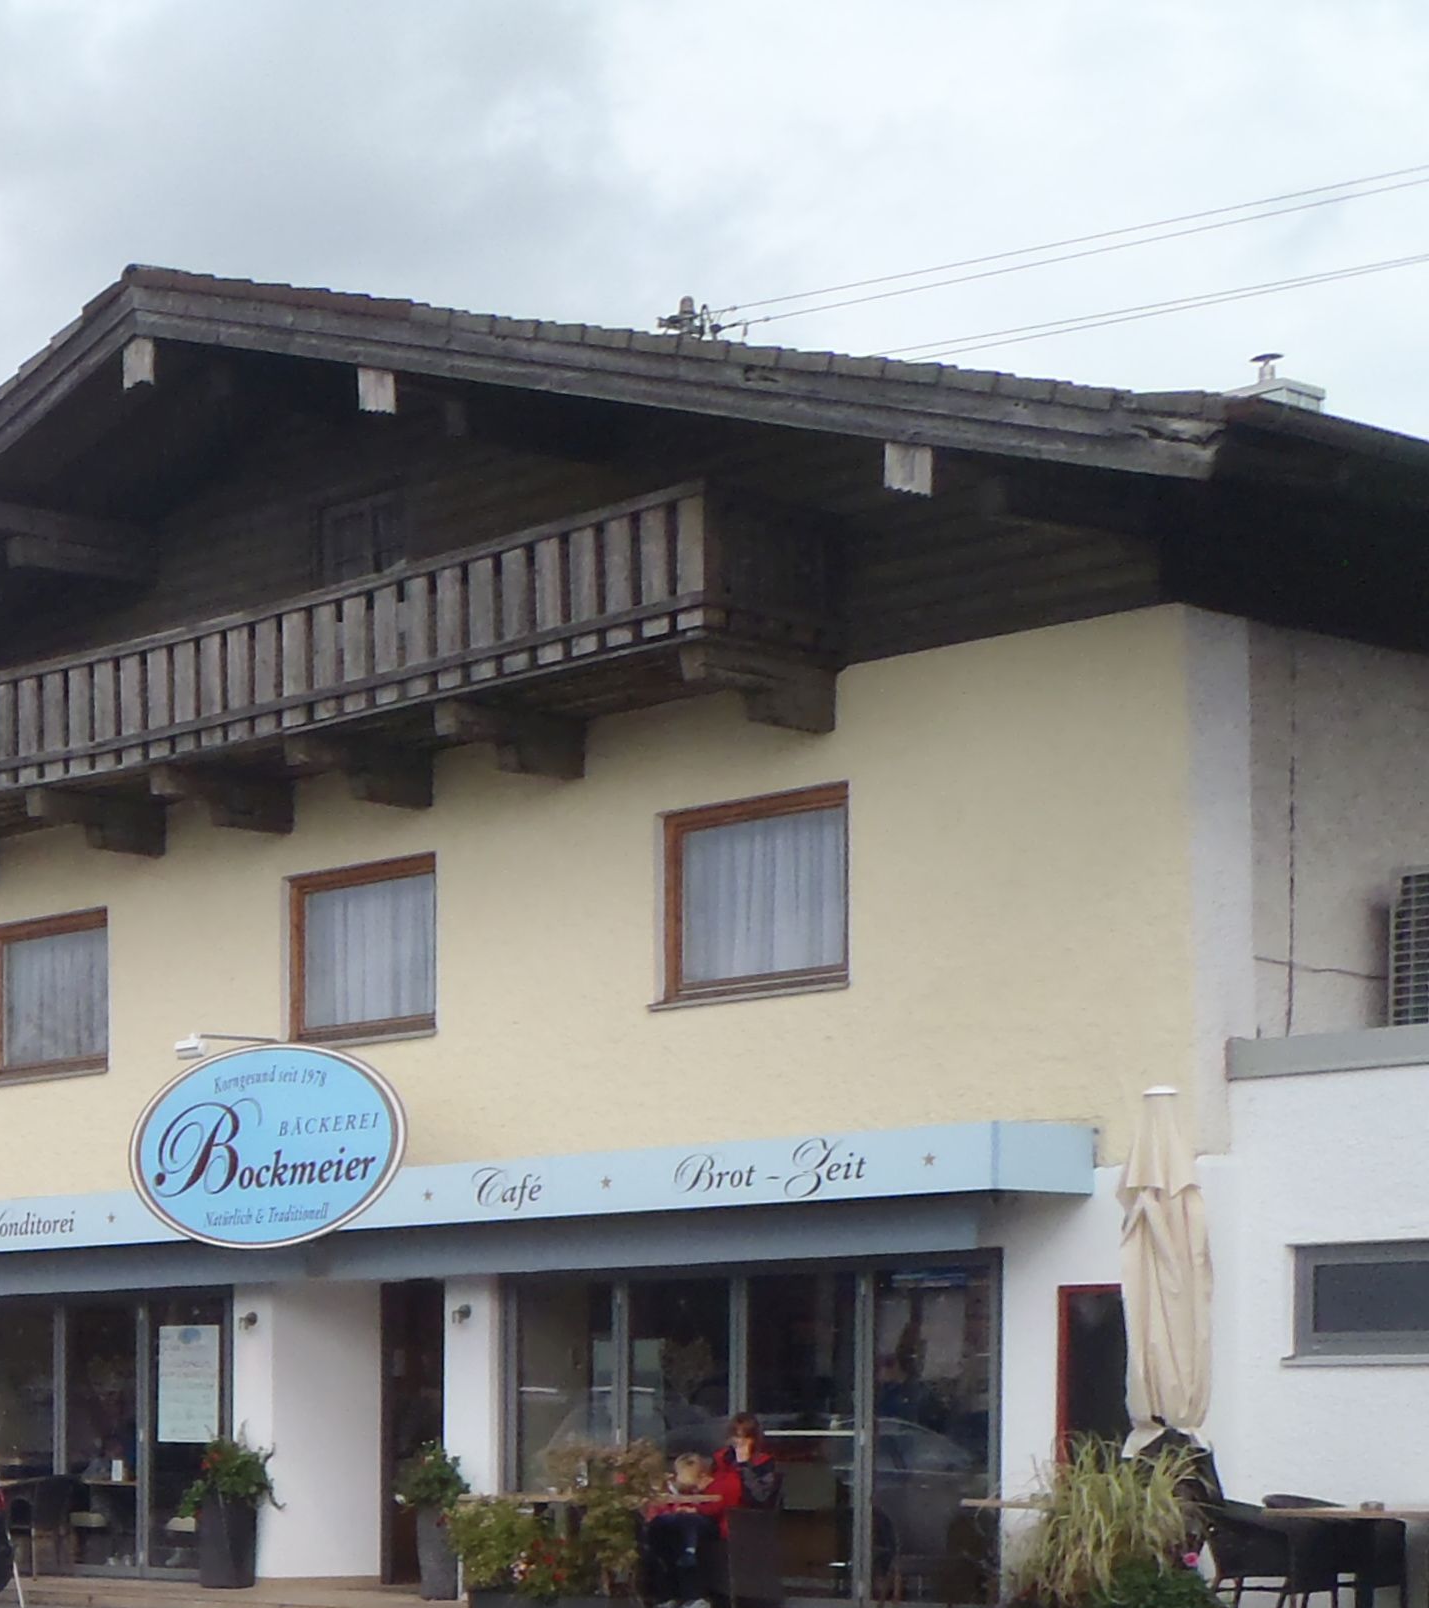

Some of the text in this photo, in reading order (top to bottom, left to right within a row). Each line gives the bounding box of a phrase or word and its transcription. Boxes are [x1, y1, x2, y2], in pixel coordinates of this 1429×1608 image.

[278, 1069, 298, 1085] seit
[300, 1067, 328, 1088] 1978
[278, 1112, 380, 1137] BÄCKEREI
[153, 1097, 377, 1198] Bockmeier
[674, 1152, 754, 1194] Brot
[783, 1137, 868, 1198] Zeit
[471, 1167, 542, 1212] Café
[203, 1202, 330, 1228] Natürlich & Traditionell
